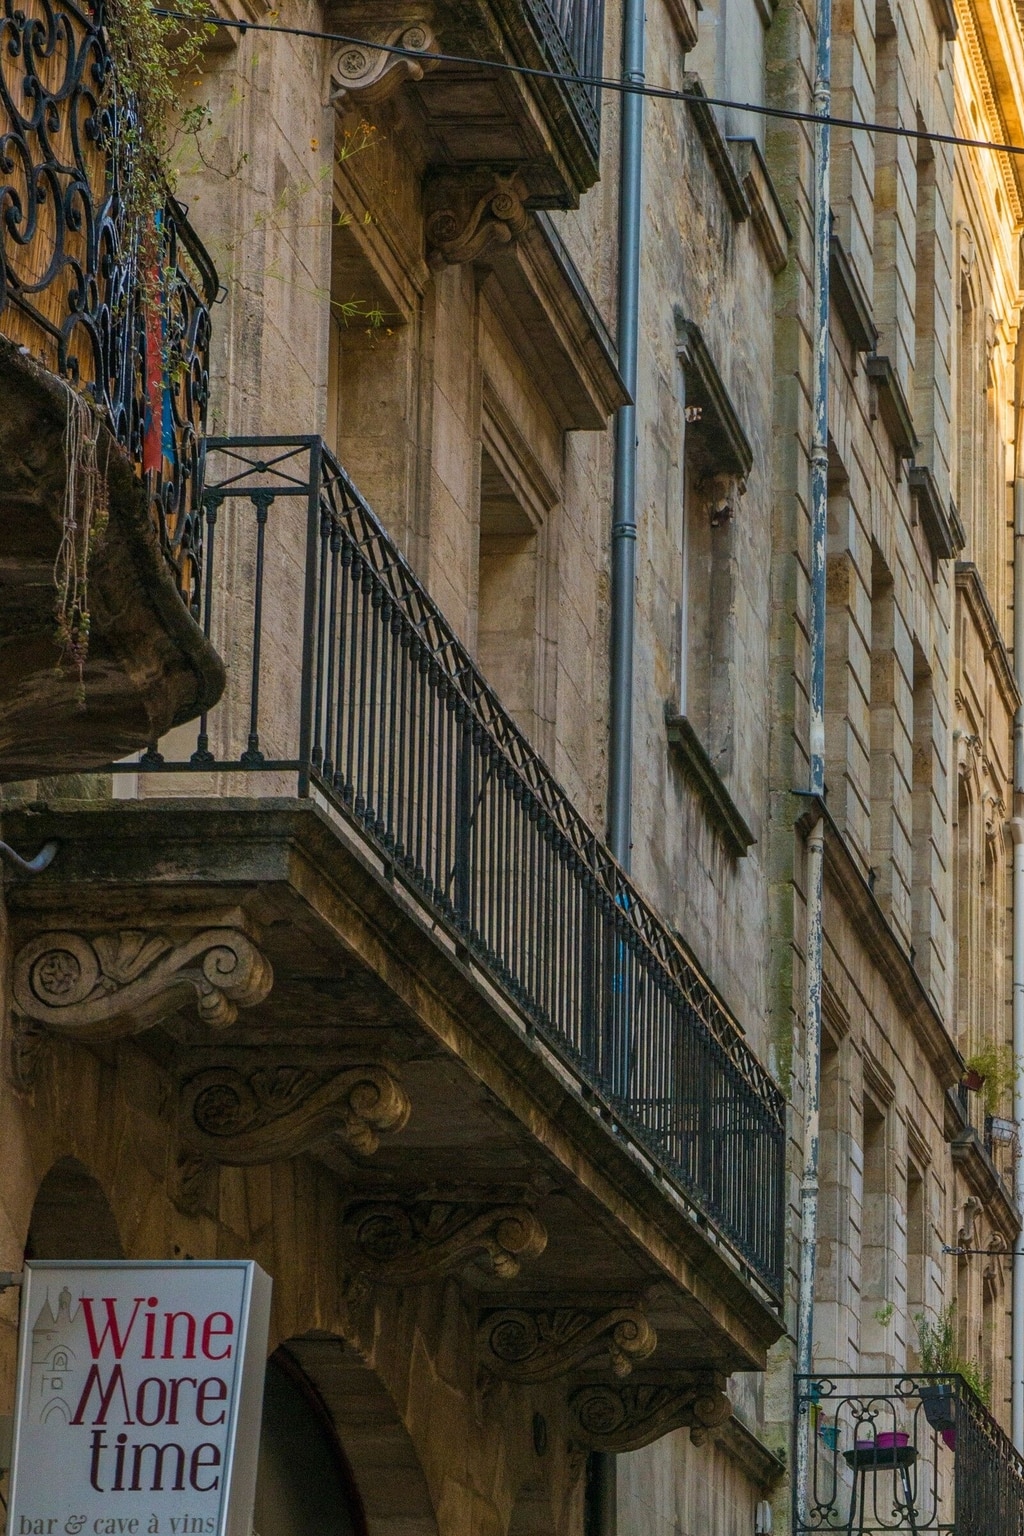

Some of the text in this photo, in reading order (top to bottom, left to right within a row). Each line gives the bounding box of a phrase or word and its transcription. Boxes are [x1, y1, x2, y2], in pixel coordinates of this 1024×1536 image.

[78, 1296, 234, 1360] Wine
[69, 1363, 227, 1426] More
[89, 1430, 221, 1493] time
[19, 1513, 215, 1535] bar & cave à vins
